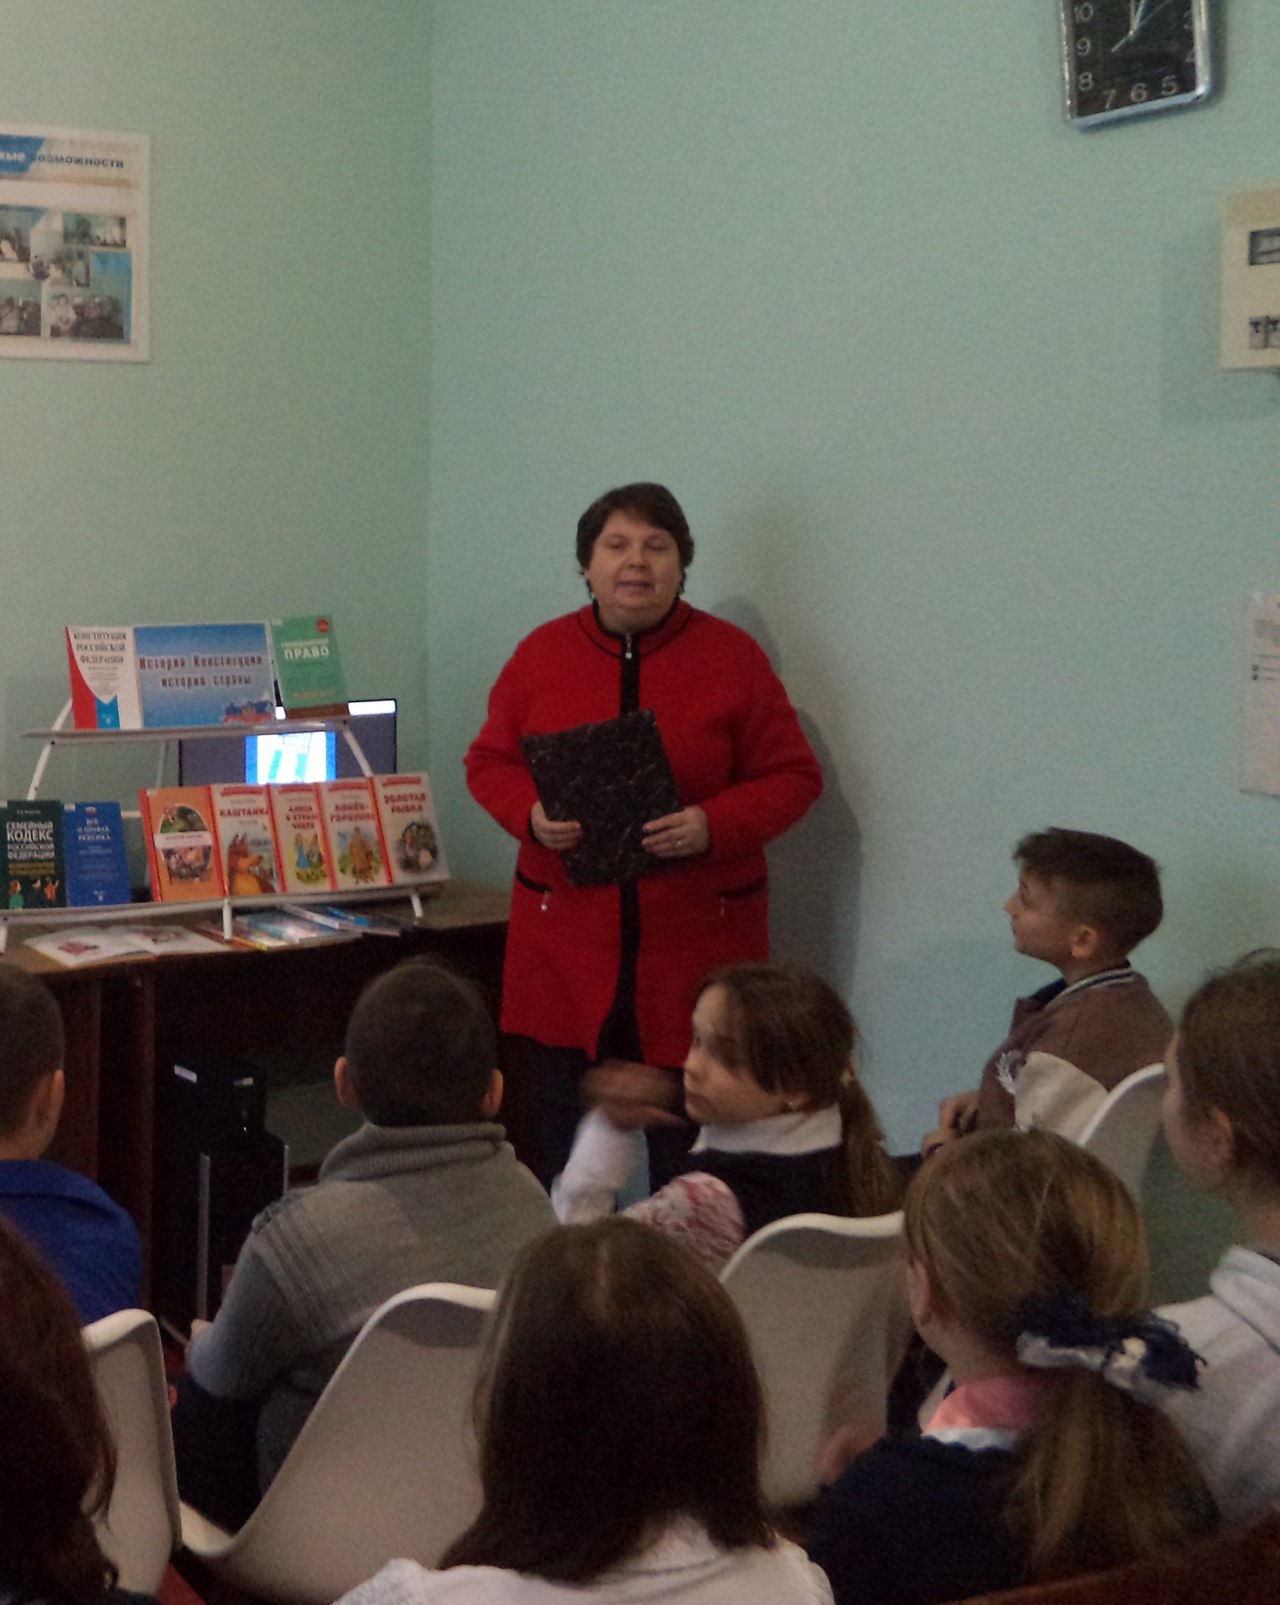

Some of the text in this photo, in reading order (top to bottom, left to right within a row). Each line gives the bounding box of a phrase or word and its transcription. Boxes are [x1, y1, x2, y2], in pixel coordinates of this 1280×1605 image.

[1076, 37, 1091, 56] 9
[1079, 71, 1093, 91] 8
[1161, 75, 1178, 96] 5
[1102, 88, 1116, 109] 7
[1131, 82, 1148, 102] 6
[34, 154, 124, 169] озможности
[283, 645, 330, 660] ПРАВО
[139, 657, 186, 670] История
[161, 674, 251, 689] история страны
[6, 829, 54, 842] КОДЕКС
